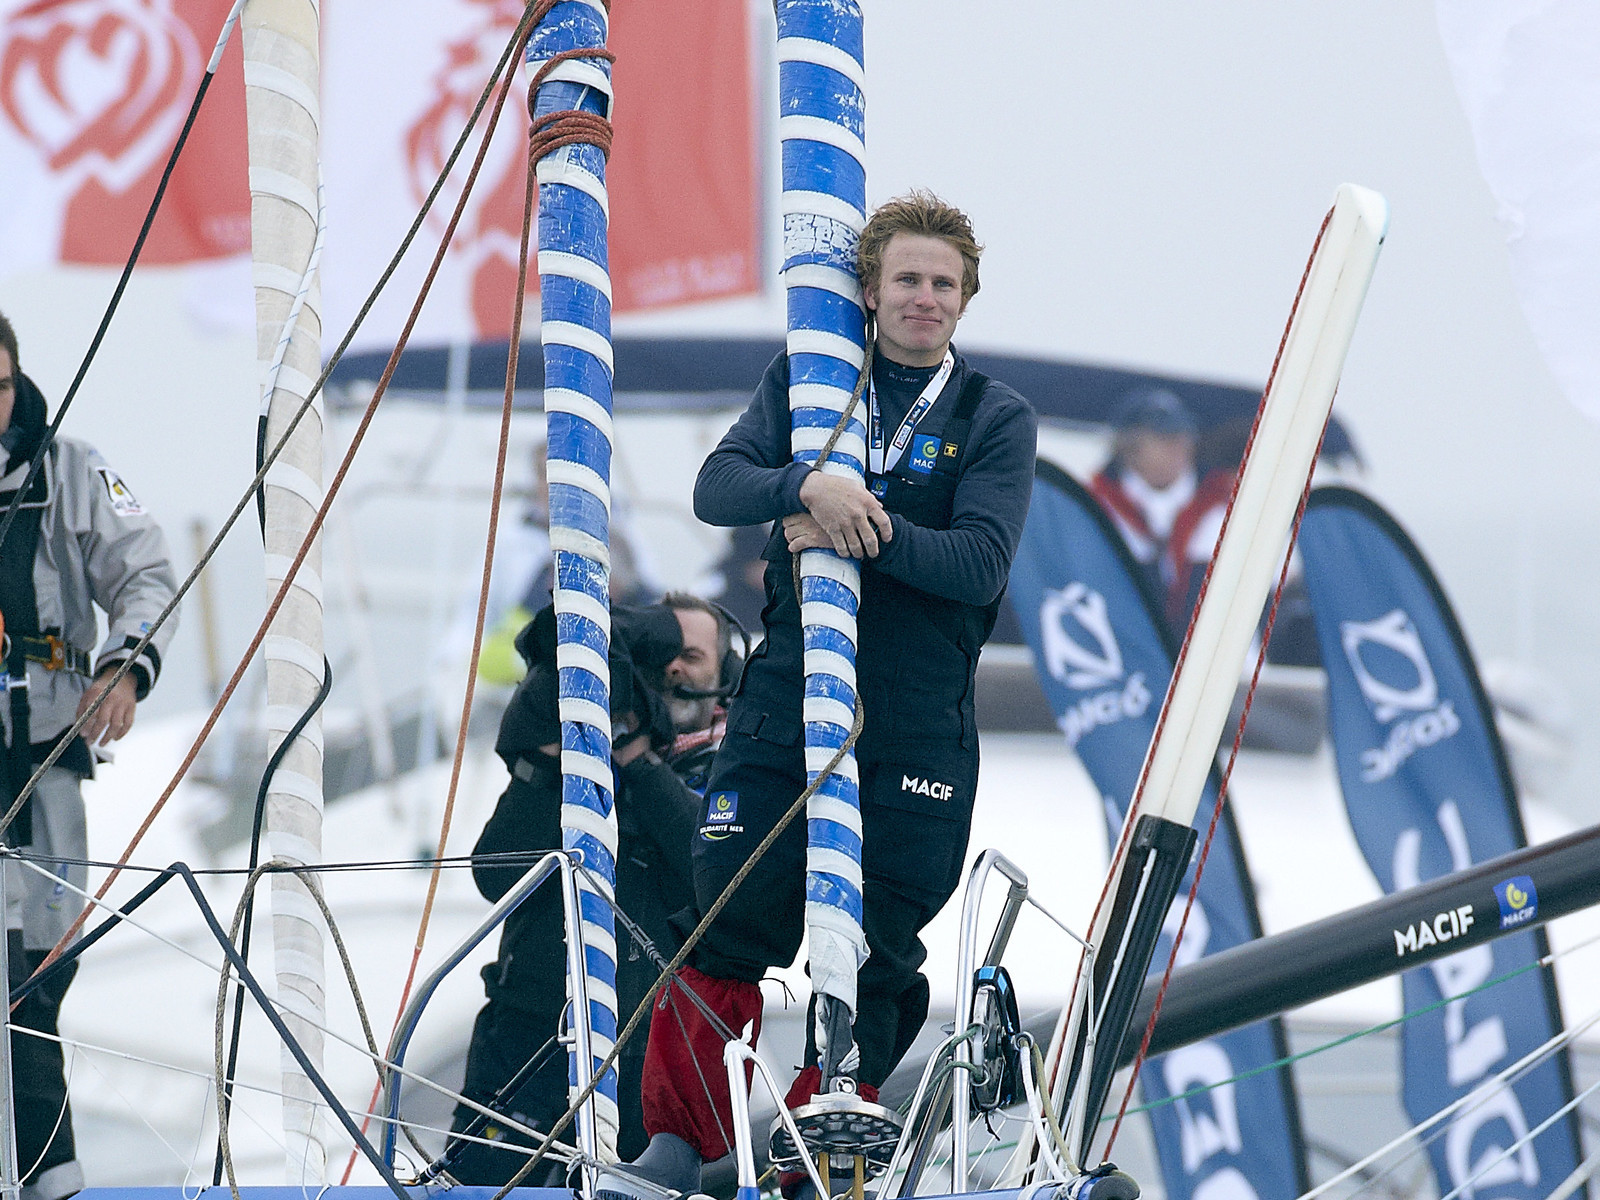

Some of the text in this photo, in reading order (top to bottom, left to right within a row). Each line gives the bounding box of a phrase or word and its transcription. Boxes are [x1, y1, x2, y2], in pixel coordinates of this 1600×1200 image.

[912, 458, 936, 470] MAC
[901, 774, 954, 801] MACIF
[710, 811, 734, 820] MACIF
[700, 824, 728, 834] OLIDARITÉ
[1503, 906, 1535, 926] MACIF
[1393, 904, 1475, 957] MACIF
